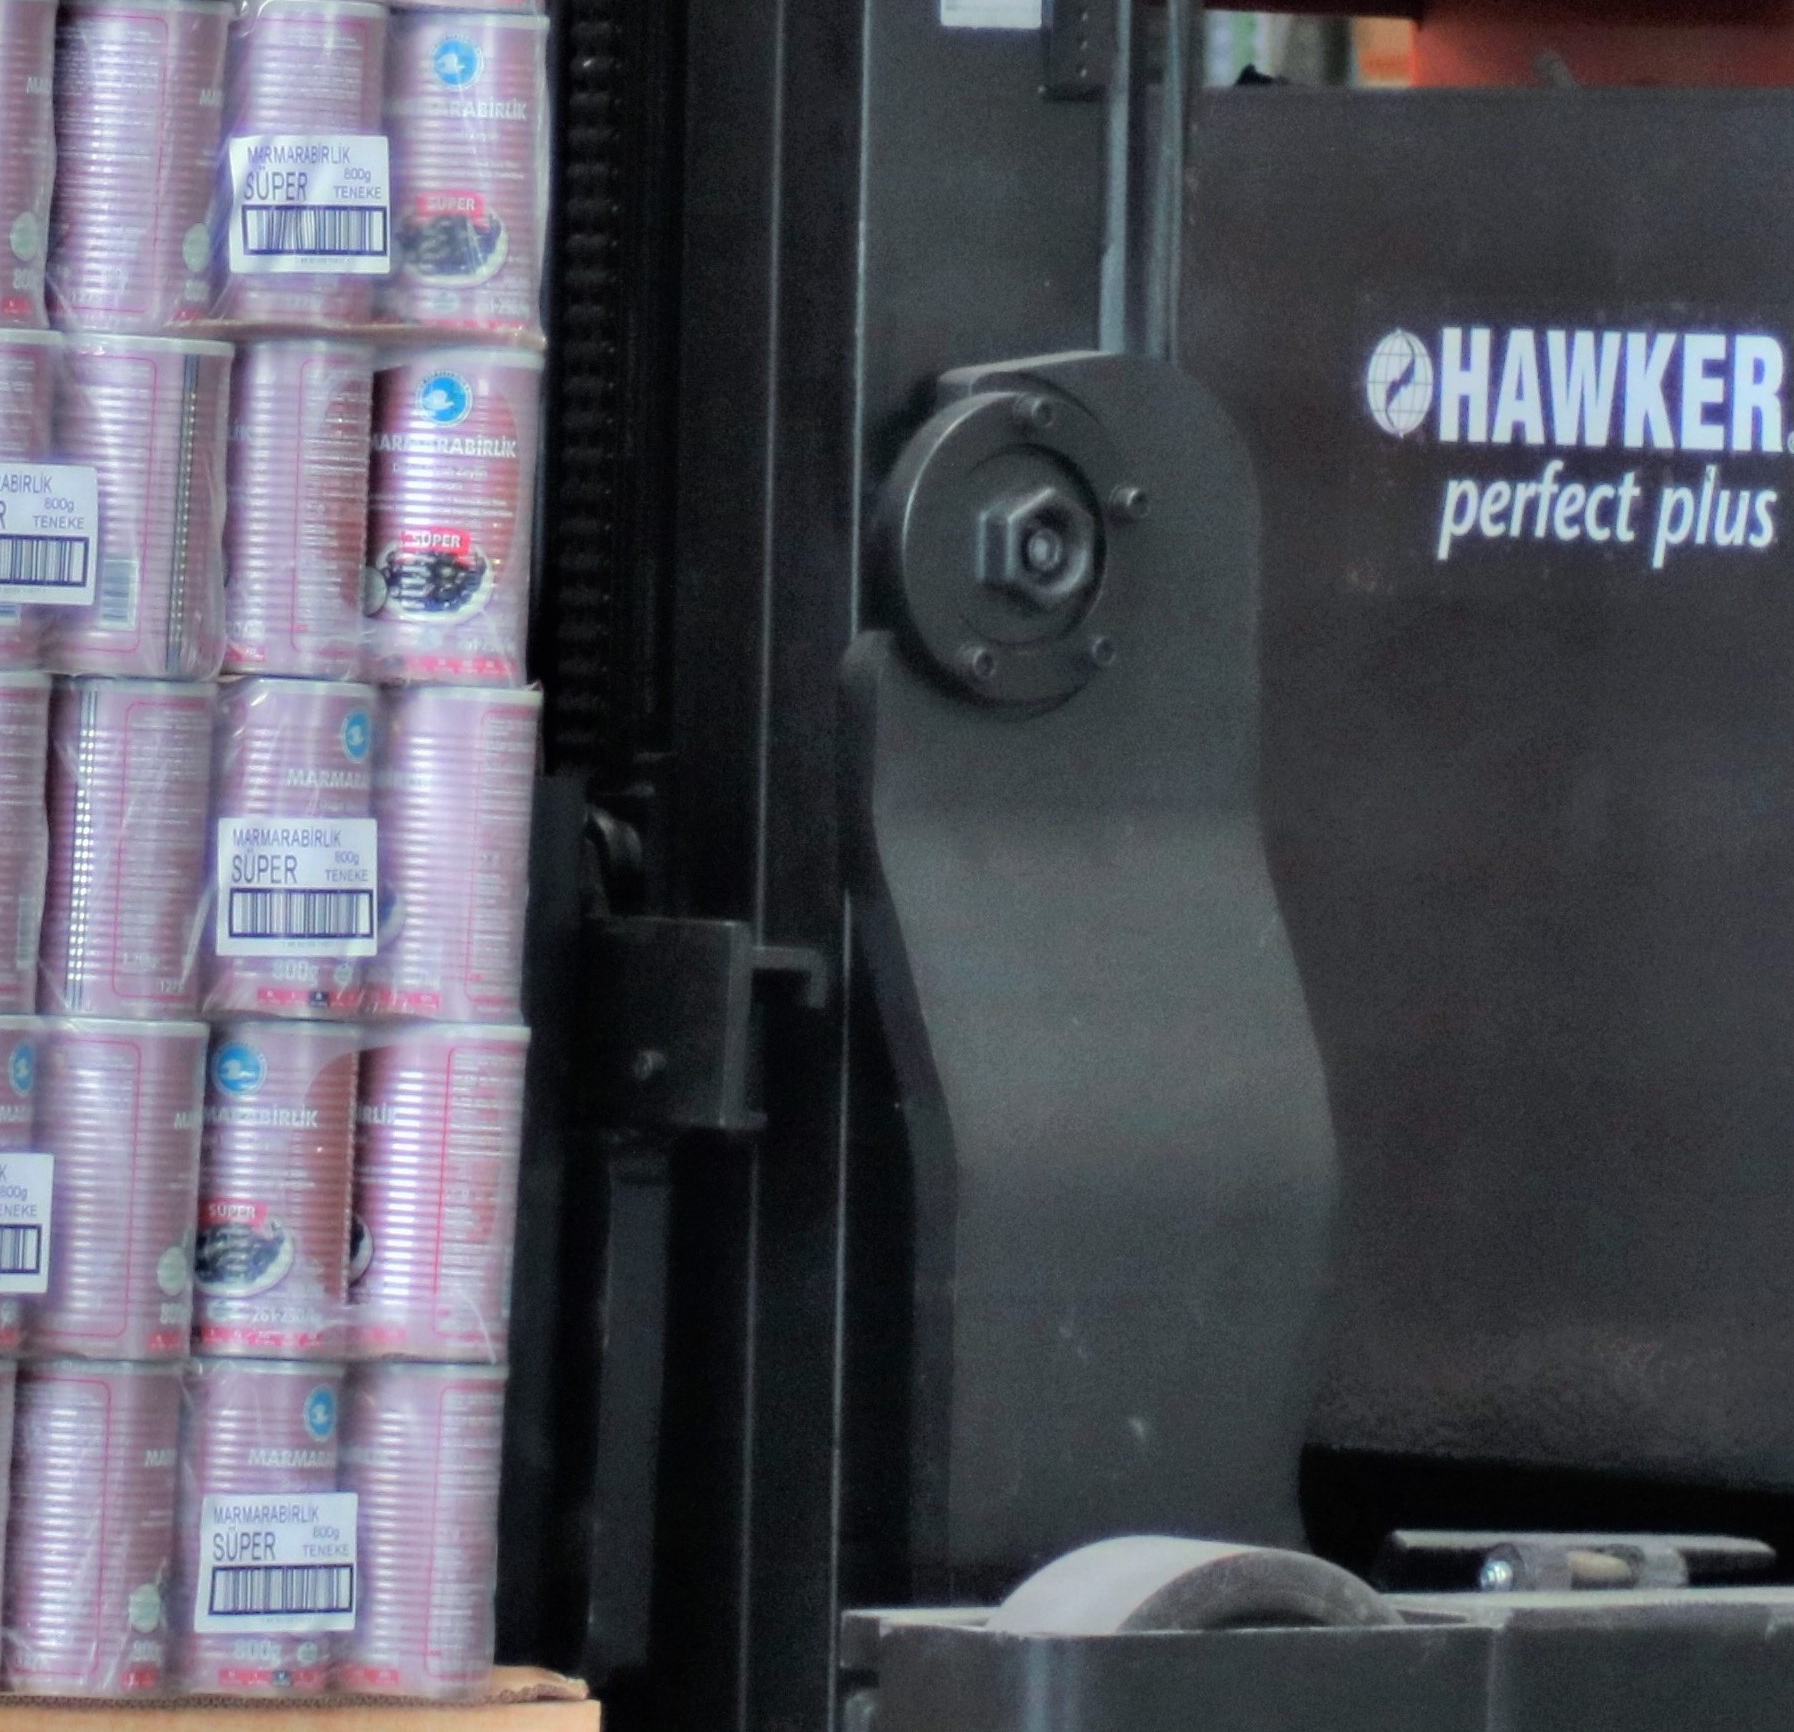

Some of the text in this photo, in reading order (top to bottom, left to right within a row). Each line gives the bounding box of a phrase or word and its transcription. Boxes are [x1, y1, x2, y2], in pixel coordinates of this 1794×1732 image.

[247, 142, 351, 165] MARMARABİRLİK
[243, 167, 309, 201] SÜPER
[343, 168, 372, 183] 800g
[333, 185, 383, 200] TENEKE
[1438, 326, 1785, 454] HAWKER
[43, 497, 75, 512] 800g
[1436, 459, 1779, 569] perfect plus
[32, 515, 85, 530] TENEKE
[232, 826, 342, 849] MARMARABİRLİK
[231, 849, 298, 885] SÜPER
[325, 869, 370, 883] TENEKE
[213, 1502, 320, 1525] MARMARABİRLİK
[212, 1526, 276, 1562] SÜPER
[303, 1544, 350, 1558] TENEKE
